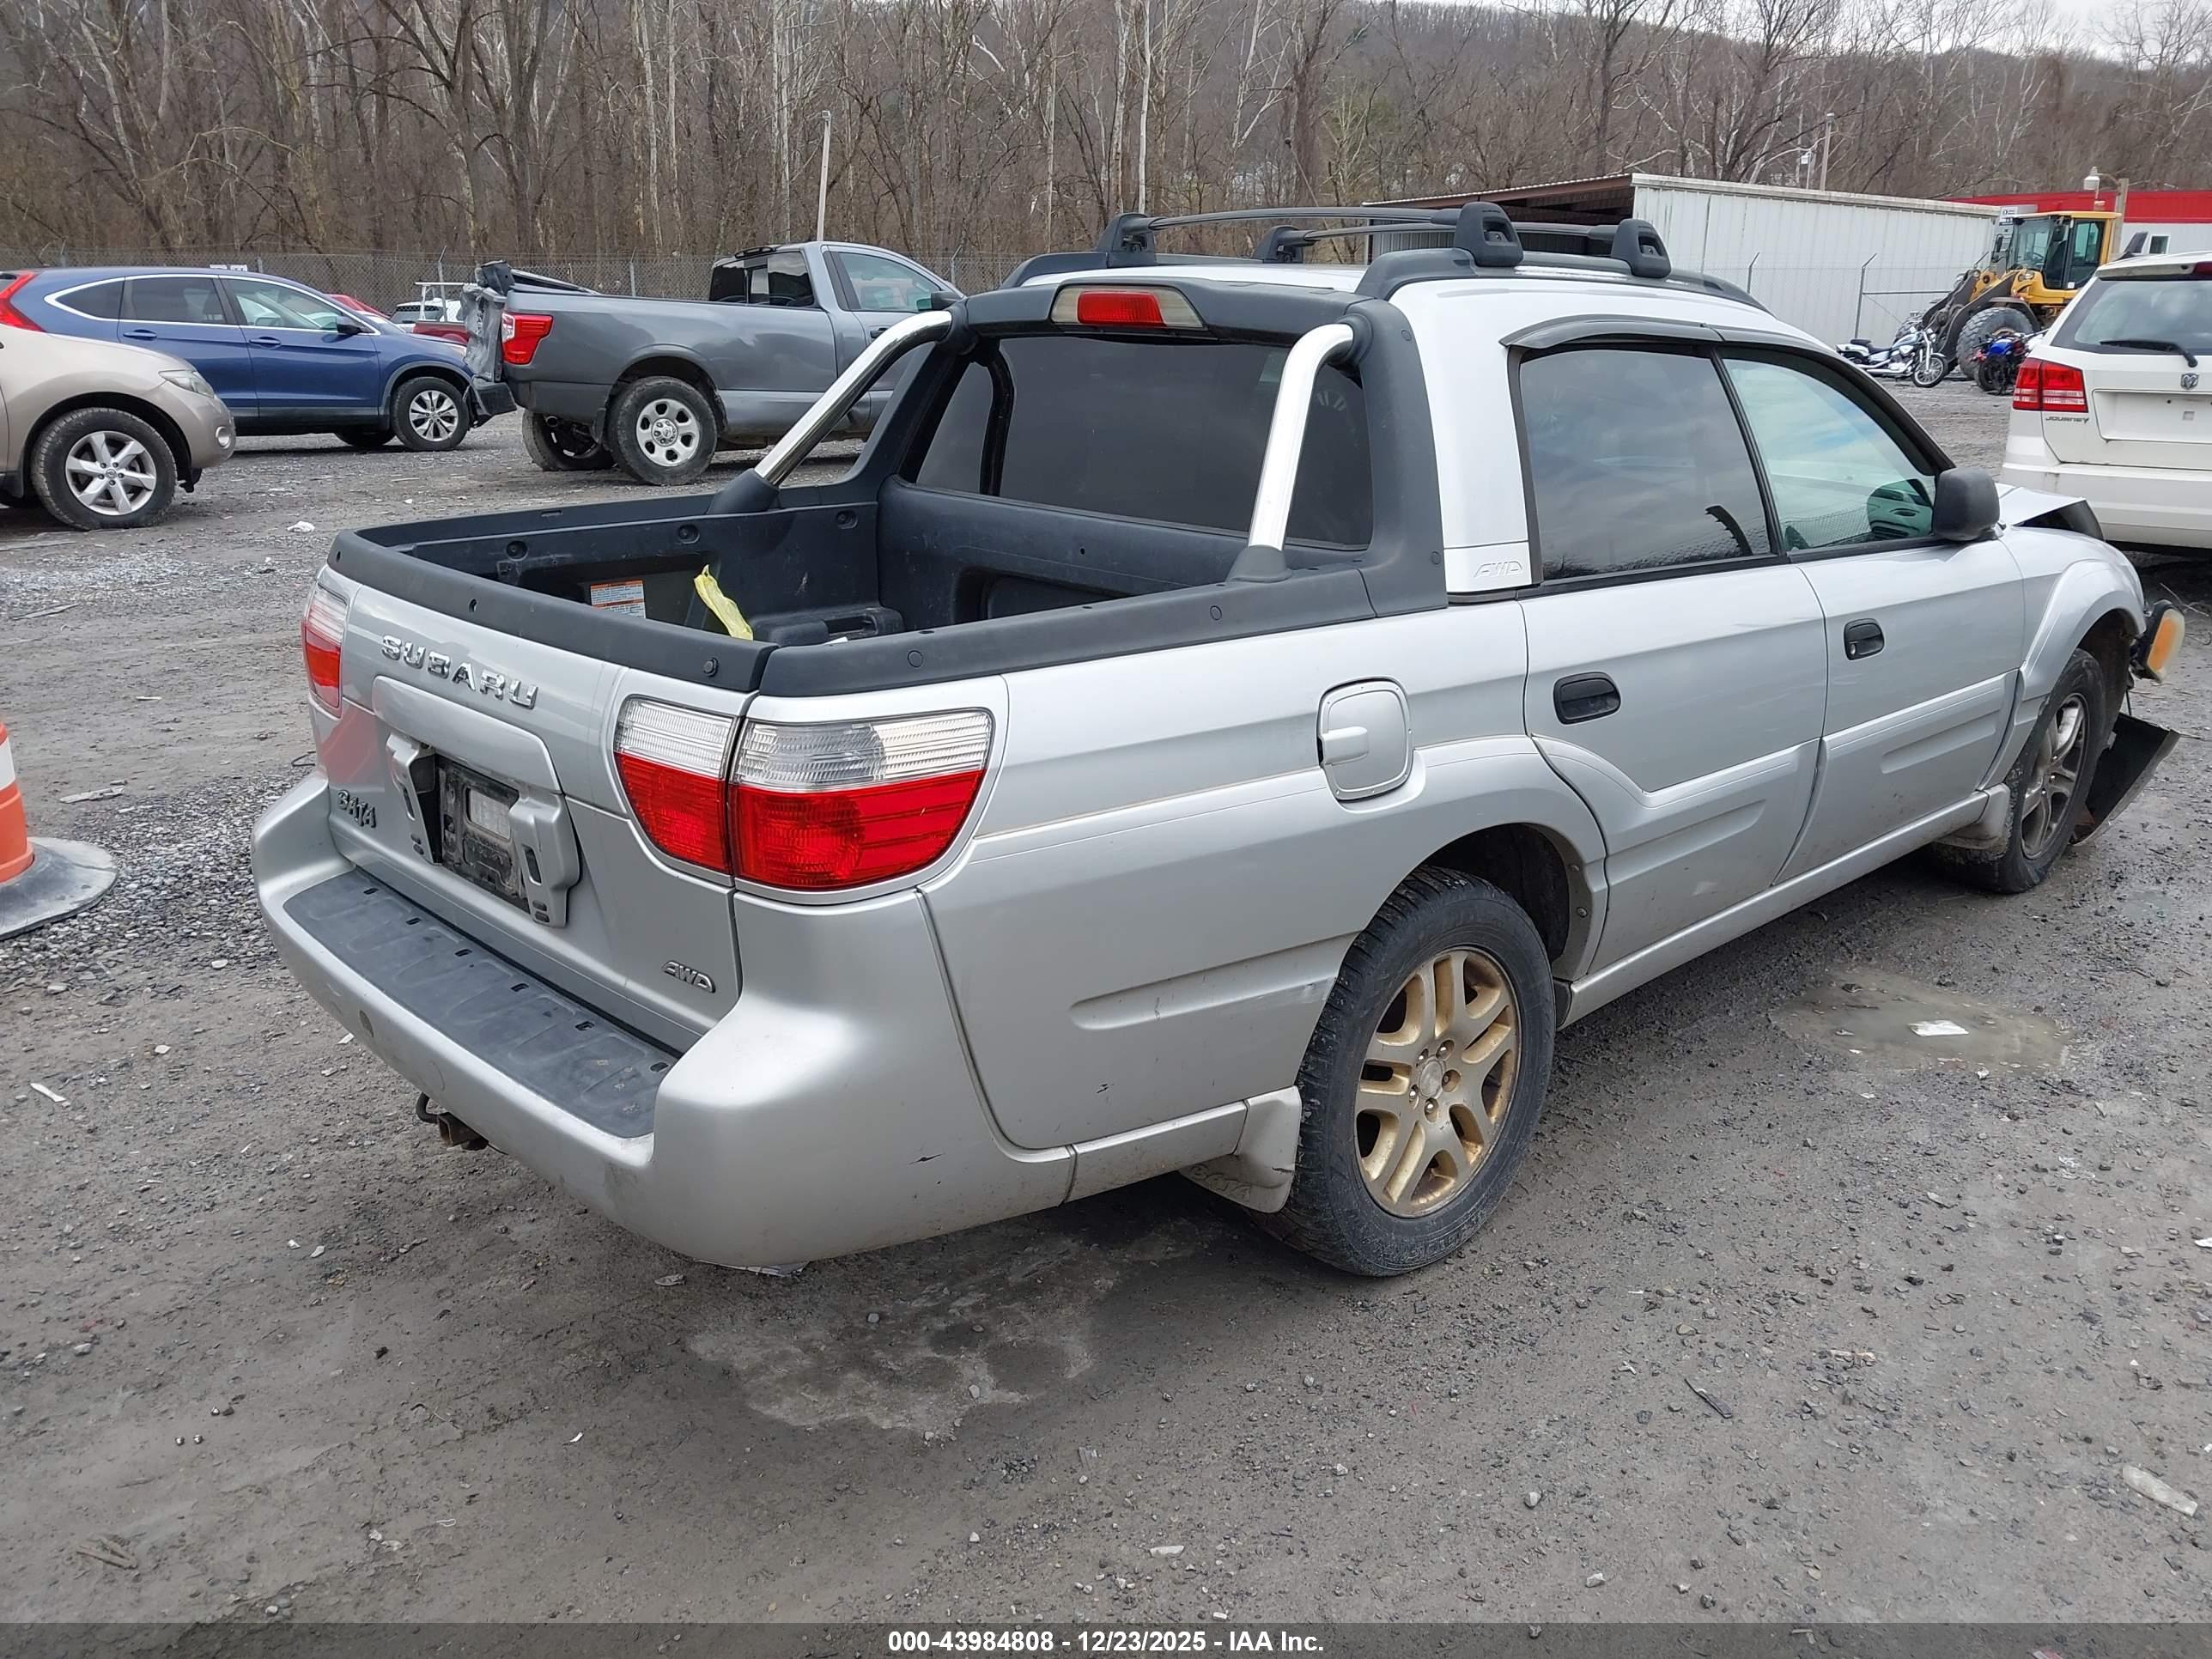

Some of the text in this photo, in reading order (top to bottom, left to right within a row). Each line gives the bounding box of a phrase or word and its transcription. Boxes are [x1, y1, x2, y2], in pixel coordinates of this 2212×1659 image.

[1474, 560, 1523, 578] AWD
[381, 635, 538, 710] SUBARU
[661, 960, 716, 994] AWD
